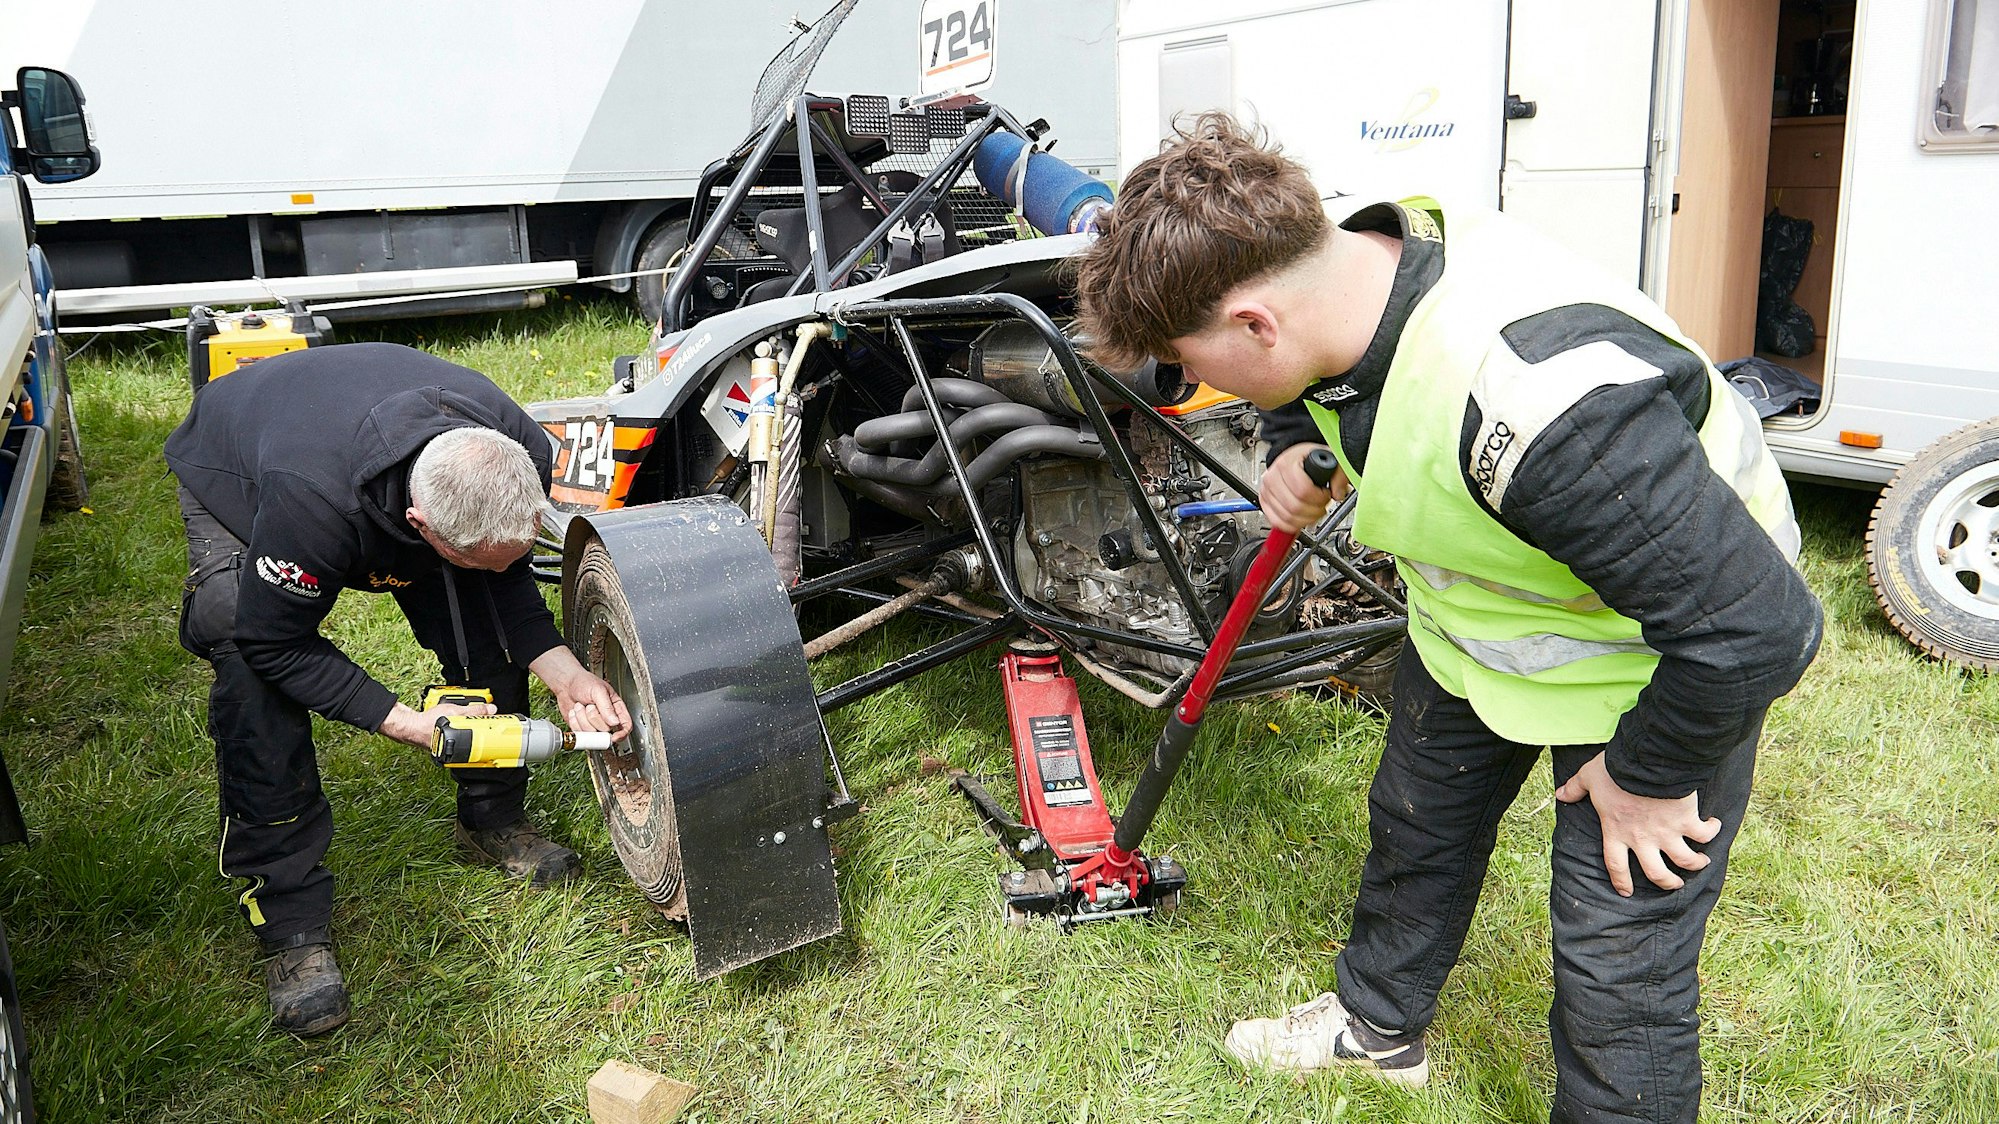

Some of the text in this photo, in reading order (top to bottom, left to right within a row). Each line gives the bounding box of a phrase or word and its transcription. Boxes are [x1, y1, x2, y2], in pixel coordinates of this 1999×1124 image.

[924, 1, 991, 67] 724
[1360, 120, 1455, 141] Ventana
[563, 417, 616, 490] 724
